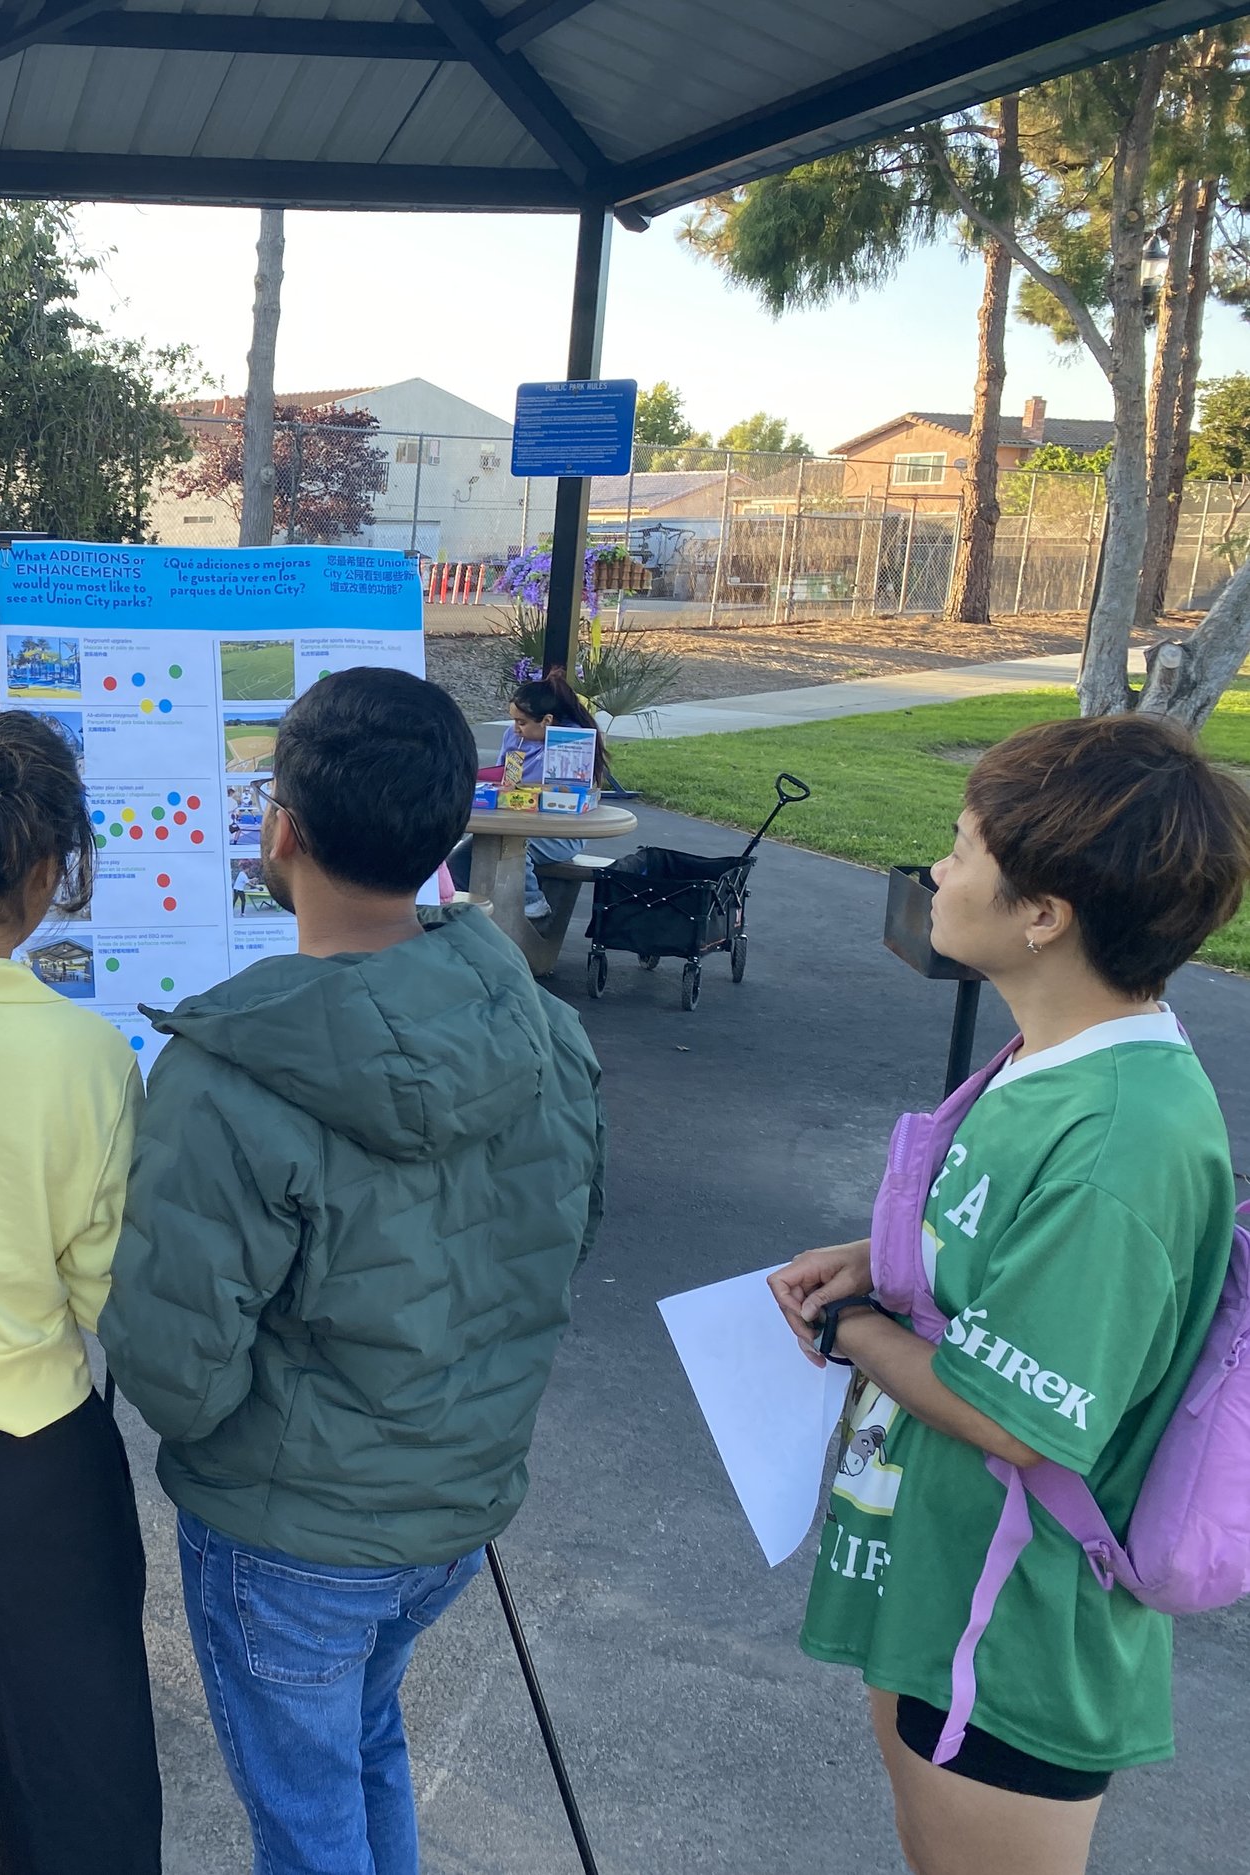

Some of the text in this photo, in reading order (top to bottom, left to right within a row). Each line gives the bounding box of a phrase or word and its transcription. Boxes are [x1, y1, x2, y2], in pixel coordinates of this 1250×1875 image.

[545, 382, 607, 392] PUBLIC PARK RULES
[11, 548, 145, 565] What ADDITIONS or
[163, 557, 193, 569] ¿Qué
[196, 557, 250, 570] adiciones
[263, 557, 311, 570] mejoras
[16, 564, 141, 579] ENHANCEMENTS
[179, 570, 188, 582] le
[241, 575, 259, 583] ver
[262, 574, 276, 582] en
[279, 570, 296, 581] los
[323, 568, 342, 580] City
[13, 577, 146, 593] would you most like to
[170, 583, 306, 598] parques de Union City?
[6, 592, 153, 609] see at Union City parks?
